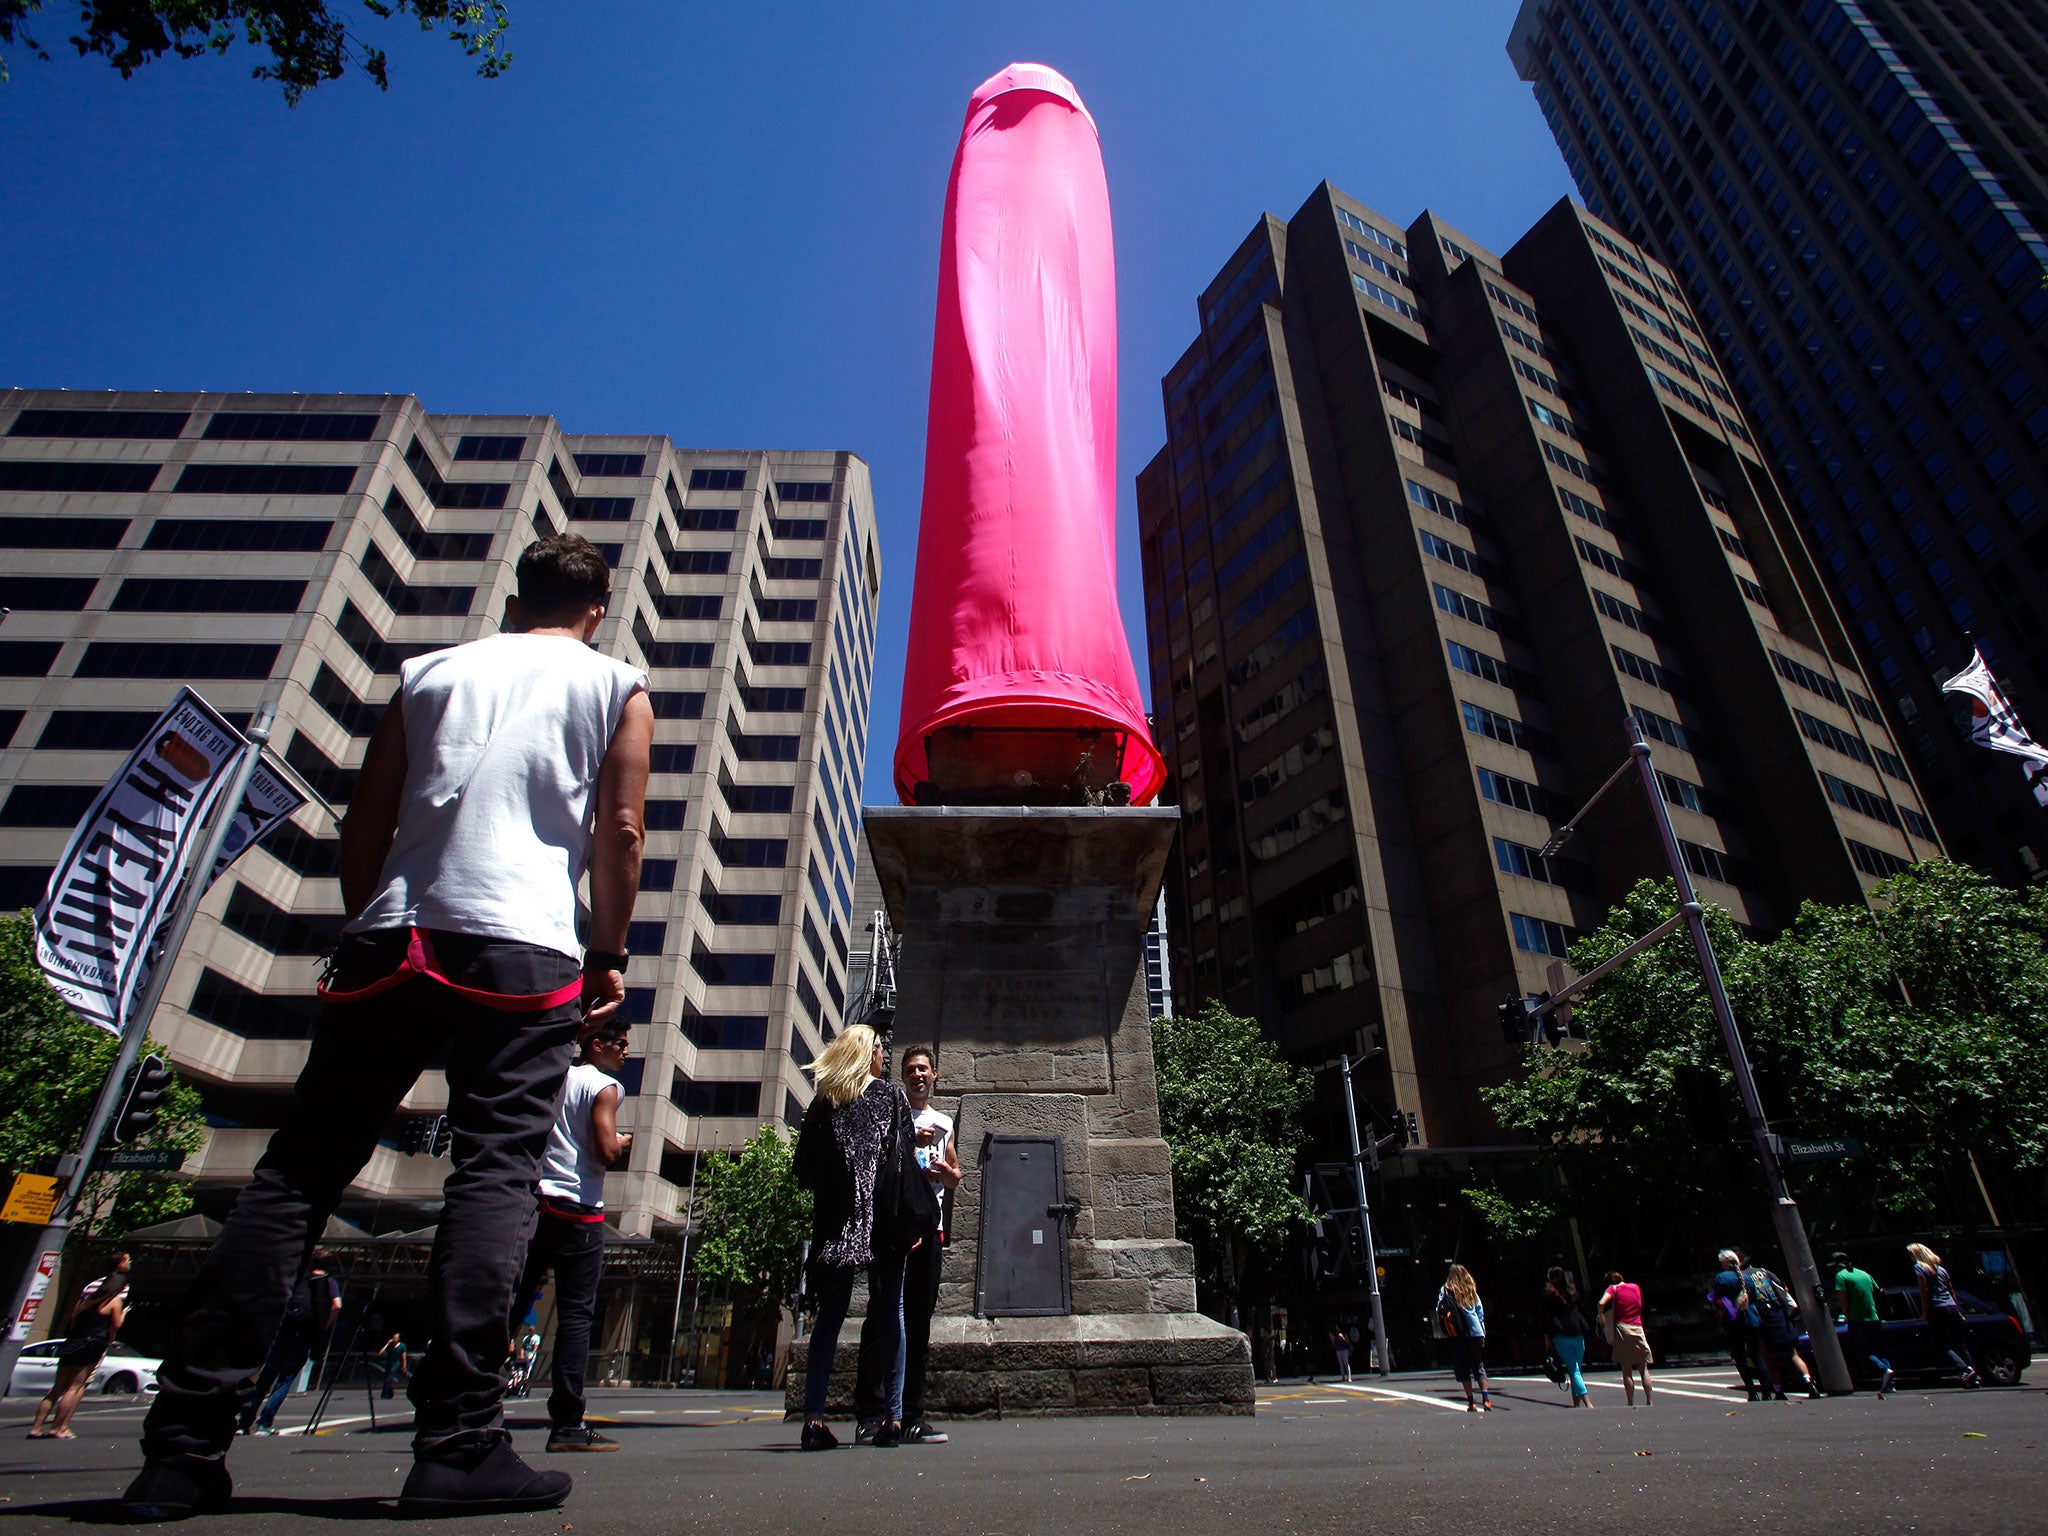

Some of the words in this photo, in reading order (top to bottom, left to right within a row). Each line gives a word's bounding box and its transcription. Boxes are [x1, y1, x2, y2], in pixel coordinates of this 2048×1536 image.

[173, 707, 213, 742] ENDING
[206, 734, 231, 756] HIV
[249, 769, 281, 800] ENDING
[111, 1151, 156, 1164] Elizabeth
[157, 1151, 169, 1164] St
[1790, 1142, 1834, 1155] Elizabeth
[1833, 1141, 1847, 1152] St
